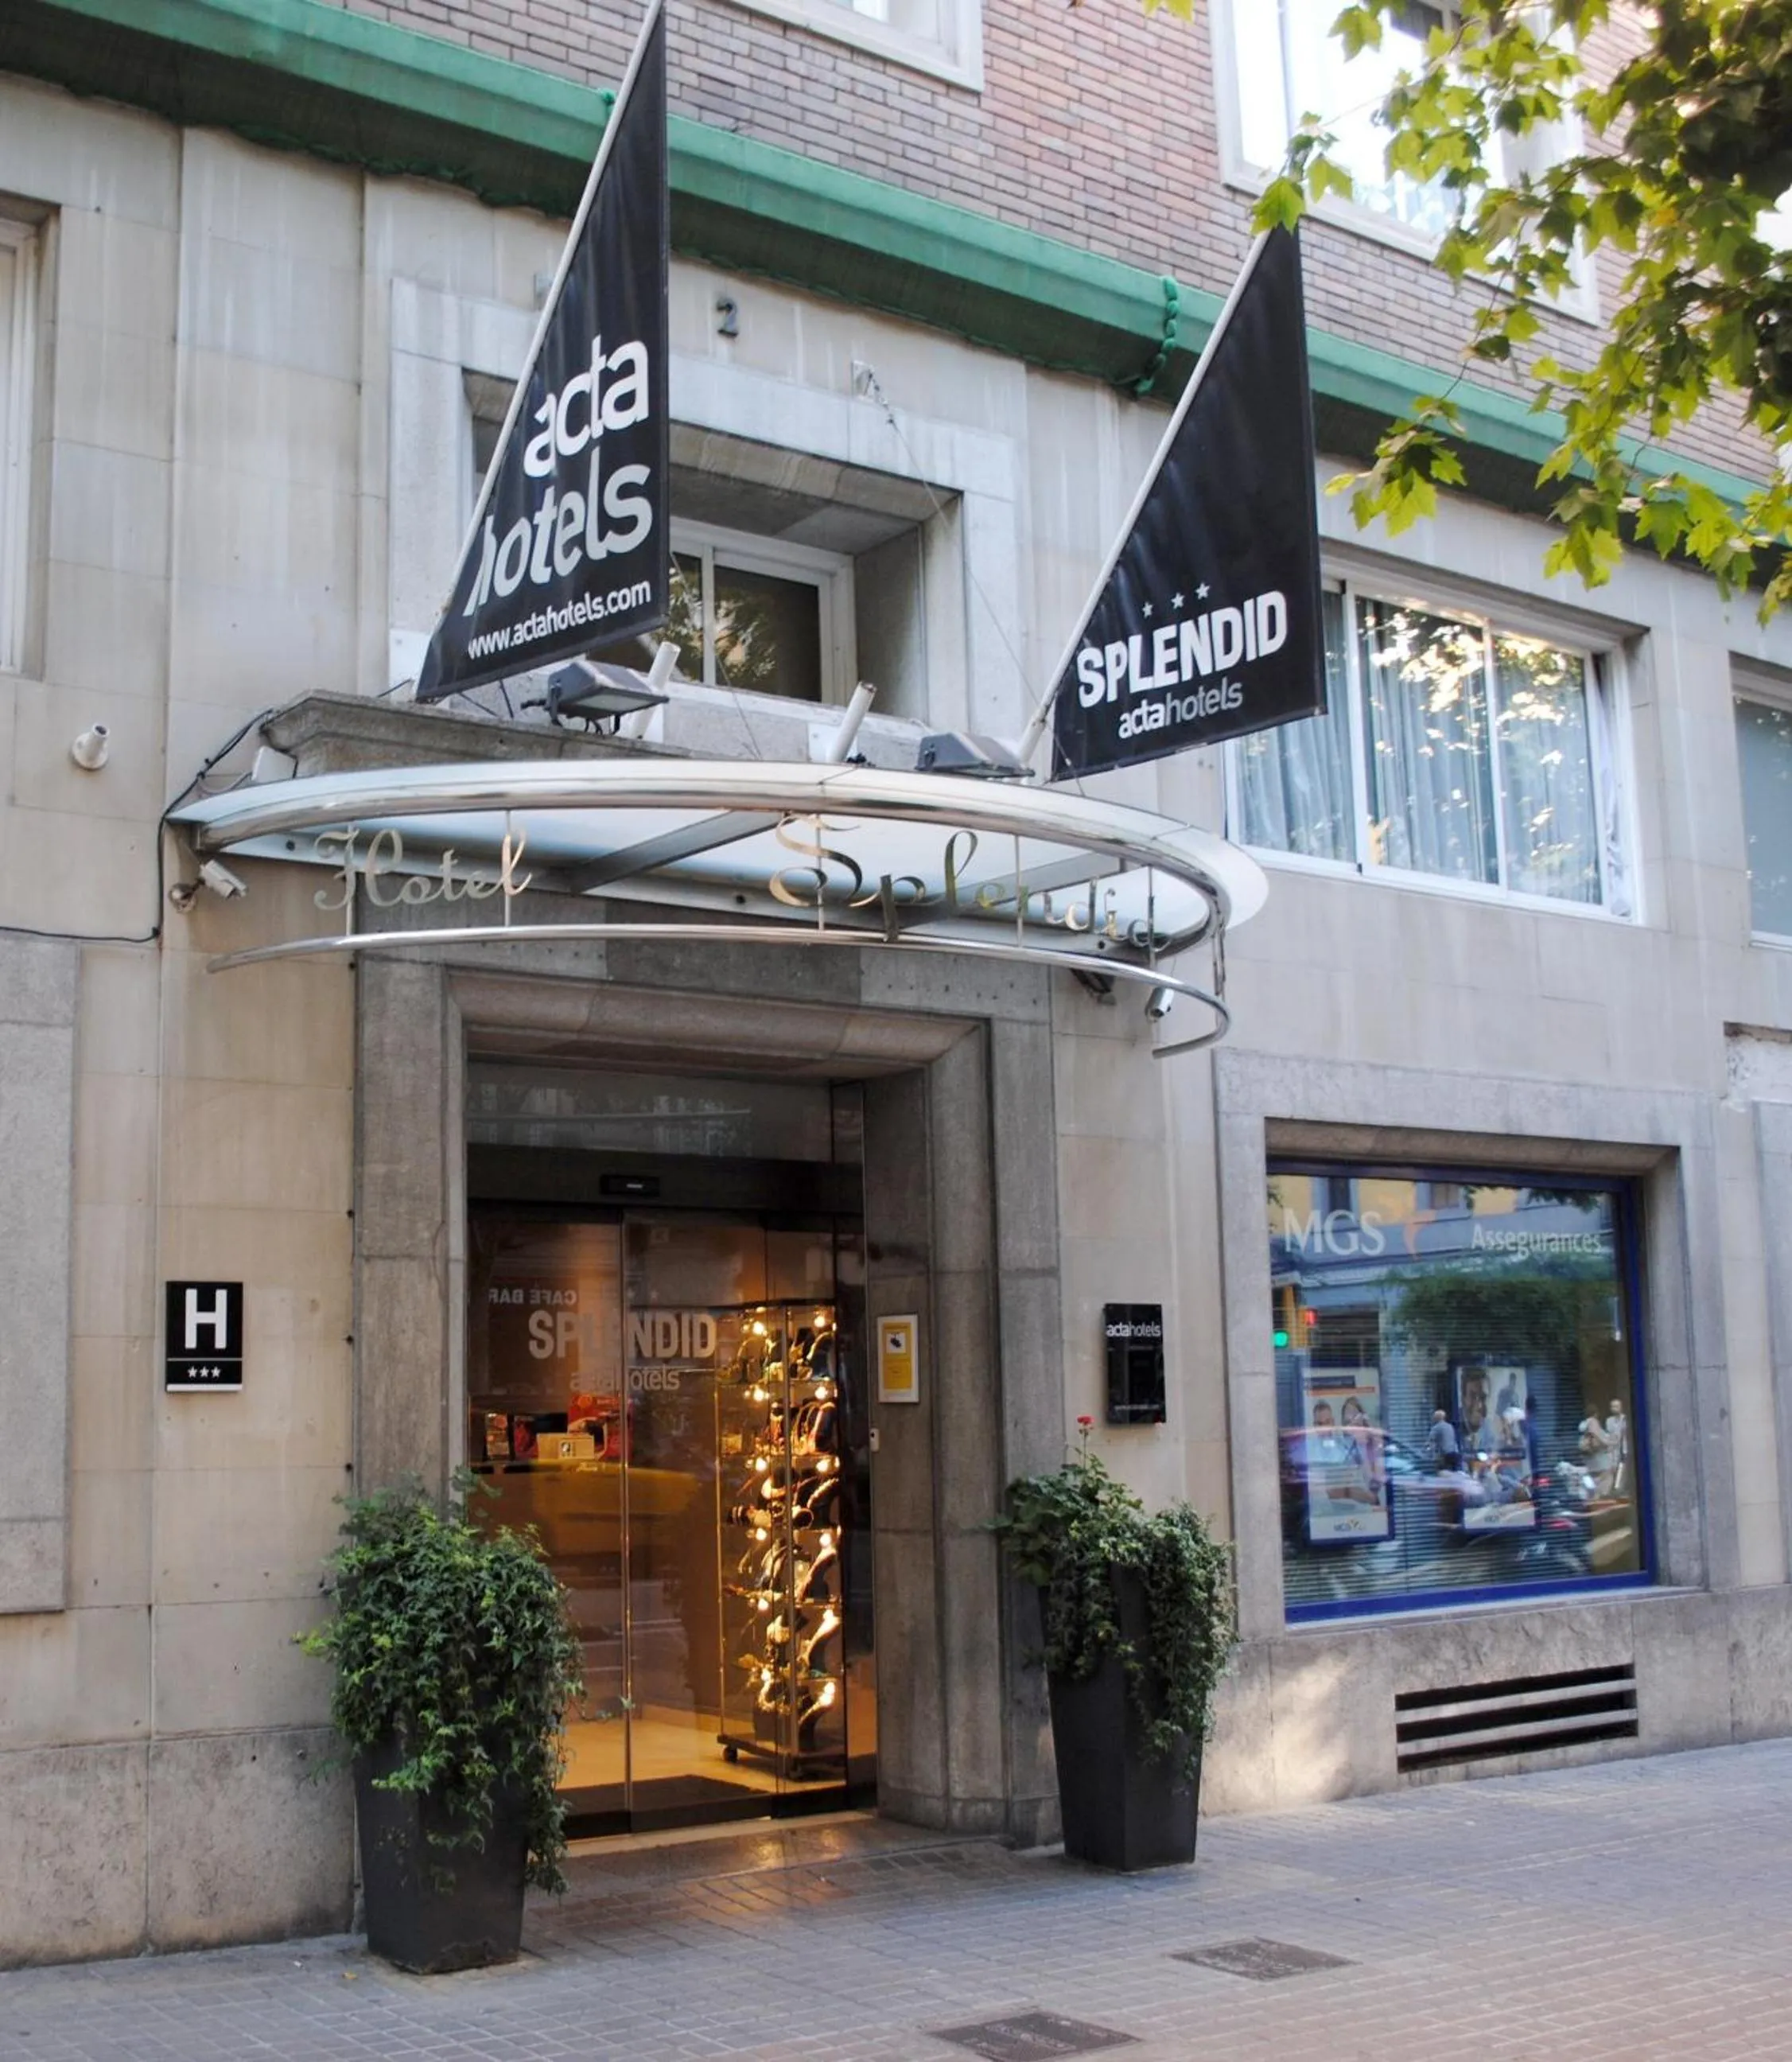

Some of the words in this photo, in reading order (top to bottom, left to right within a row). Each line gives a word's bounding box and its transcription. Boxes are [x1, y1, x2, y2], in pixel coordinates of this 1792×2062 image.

[716, 298, 739, 338] 2
[523, 334, 649, 477] acta
[463, 446, 654, 617] hotels
[468, 581, 651, 660] www.actahotels.com
[1076, 590, 1288, 709] SPLENDID
[1118, 677, 1243, 739] actahotels
[313, 823, 533, 910] Hotel
[1283, 1208, 1386, 1255] MGS
[1471, 1224, 1602, 1259] Assegurances
[185, 1288, 227, 1349] H
[1106, 1321, 1161, 1337] actahotels
